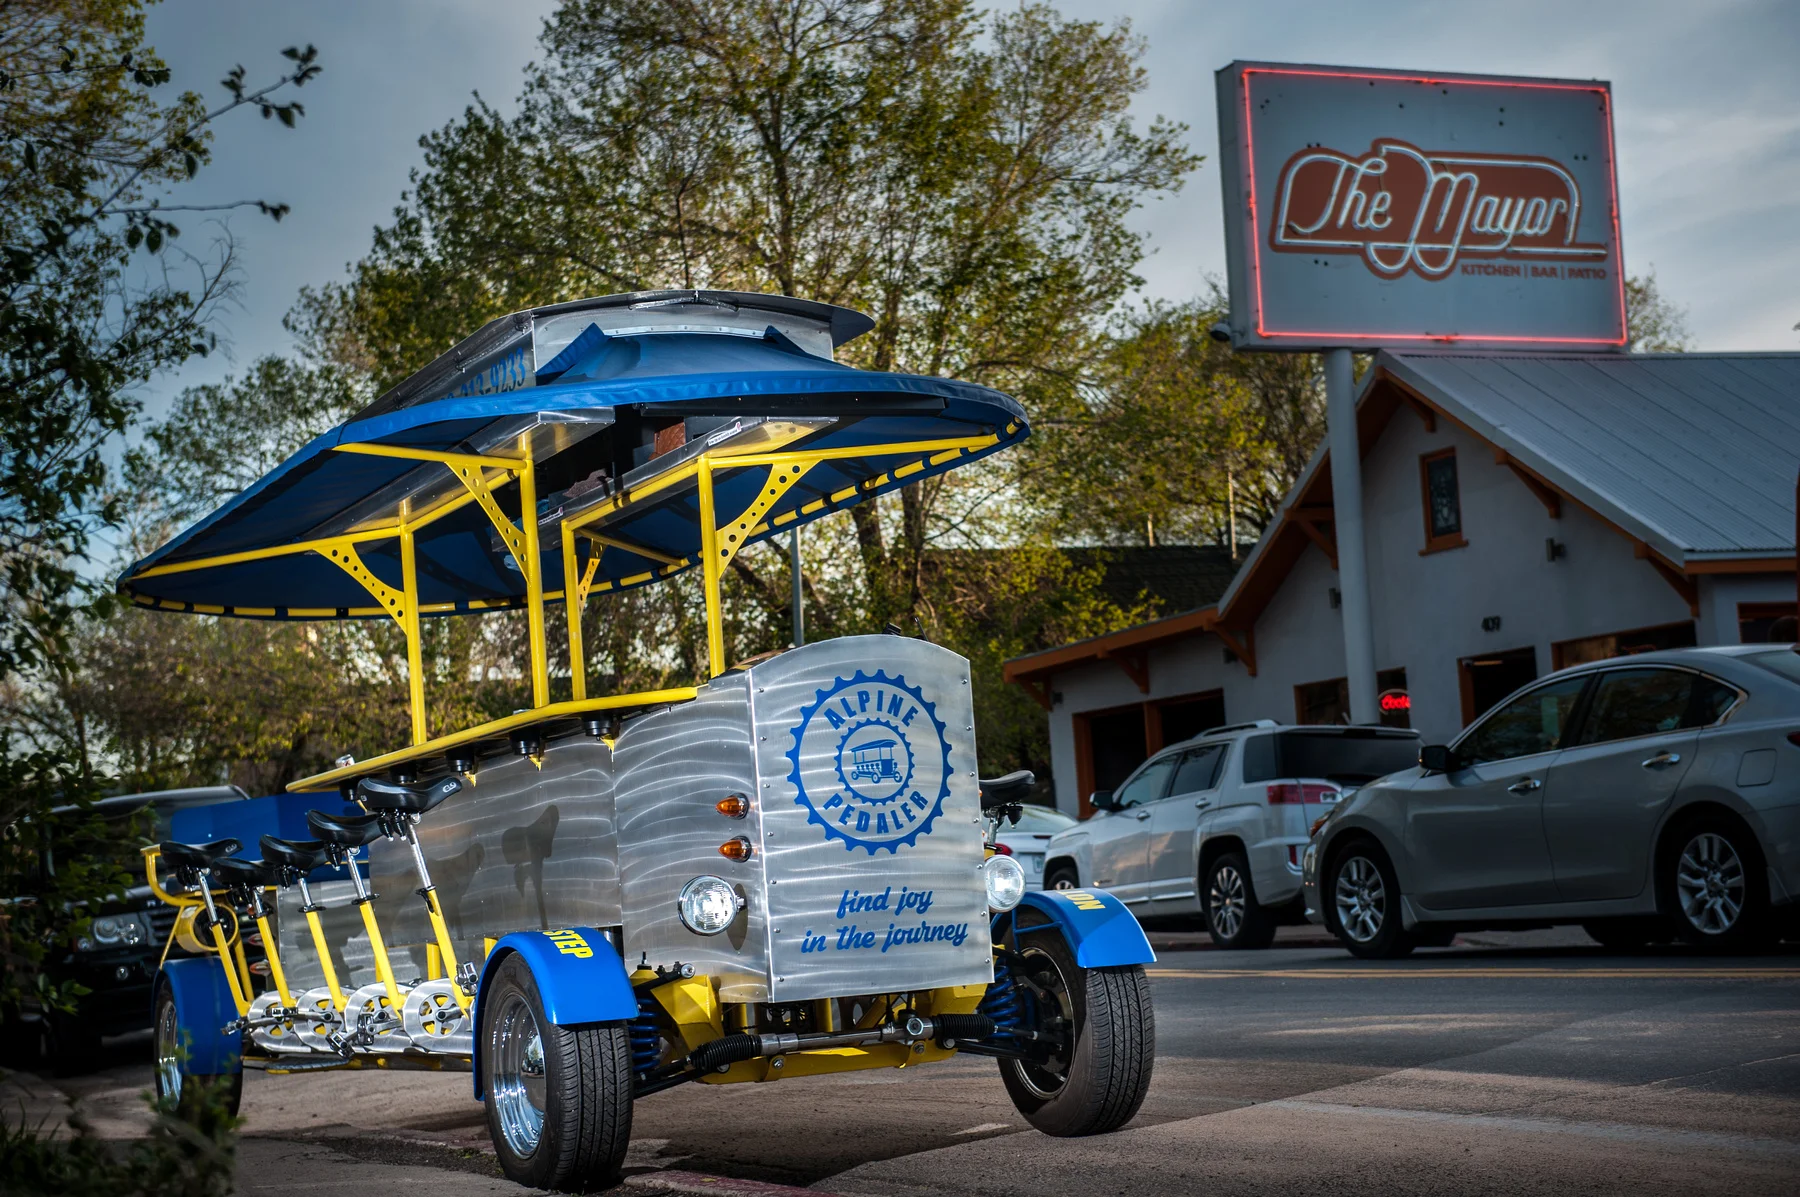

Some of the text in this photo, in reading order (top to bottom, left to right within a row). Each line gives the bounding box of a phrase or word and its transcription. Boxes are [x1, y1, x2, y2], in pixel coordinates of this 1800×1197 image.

[1277, 144, 1569, 275] The Mayor
[1461, 263, 1607, 281] KITCHEN BAR PATIO
[823, 689, 919, 731] ALPINE
[822, 790, 929, 835] PEDALER
[836, 886, 934, 920] find joy
[542, 929, 594, 959] STEP
[800, 920, 969, 954] in the journey
